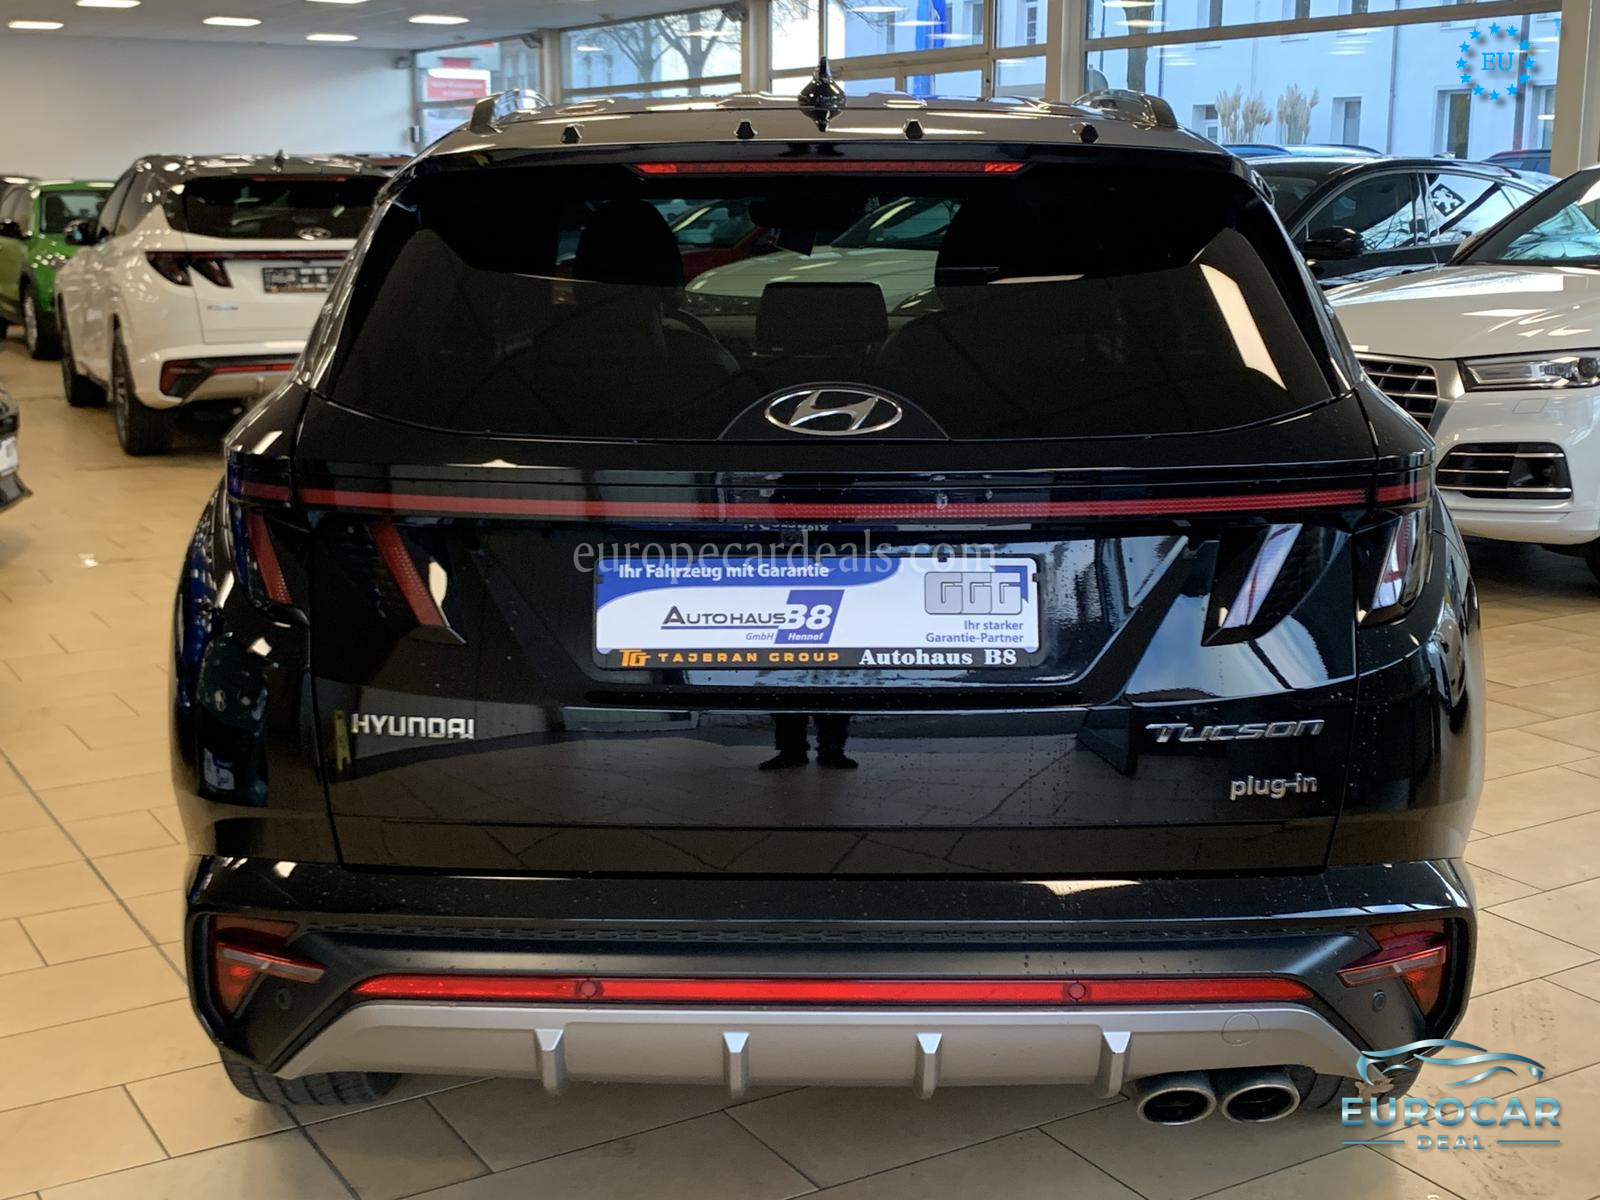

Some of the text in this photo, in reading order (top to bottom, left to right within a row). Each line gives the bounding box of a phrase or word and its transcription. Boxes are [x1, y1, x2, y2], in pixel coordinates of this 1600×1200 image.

[619, 563, 829, 580] Ihr Fahrzeug mit Garantie
[786, 604, 833, 630] B8
[964, 620, 1024, 631] Ihr starker
[745, 632, 825, 641] GmbH Hennef
[926, 632, 1024, 643] Garantie-Partner
[658, 652, 758, 663] TAJERAN
[769, 652, 840, 663] GROUP
[859, 649, 1017, 665] Autohaus B8
[352, 713, 475, 740] HYUNDAI
[1230, 772, 1318, 801] plug-in
